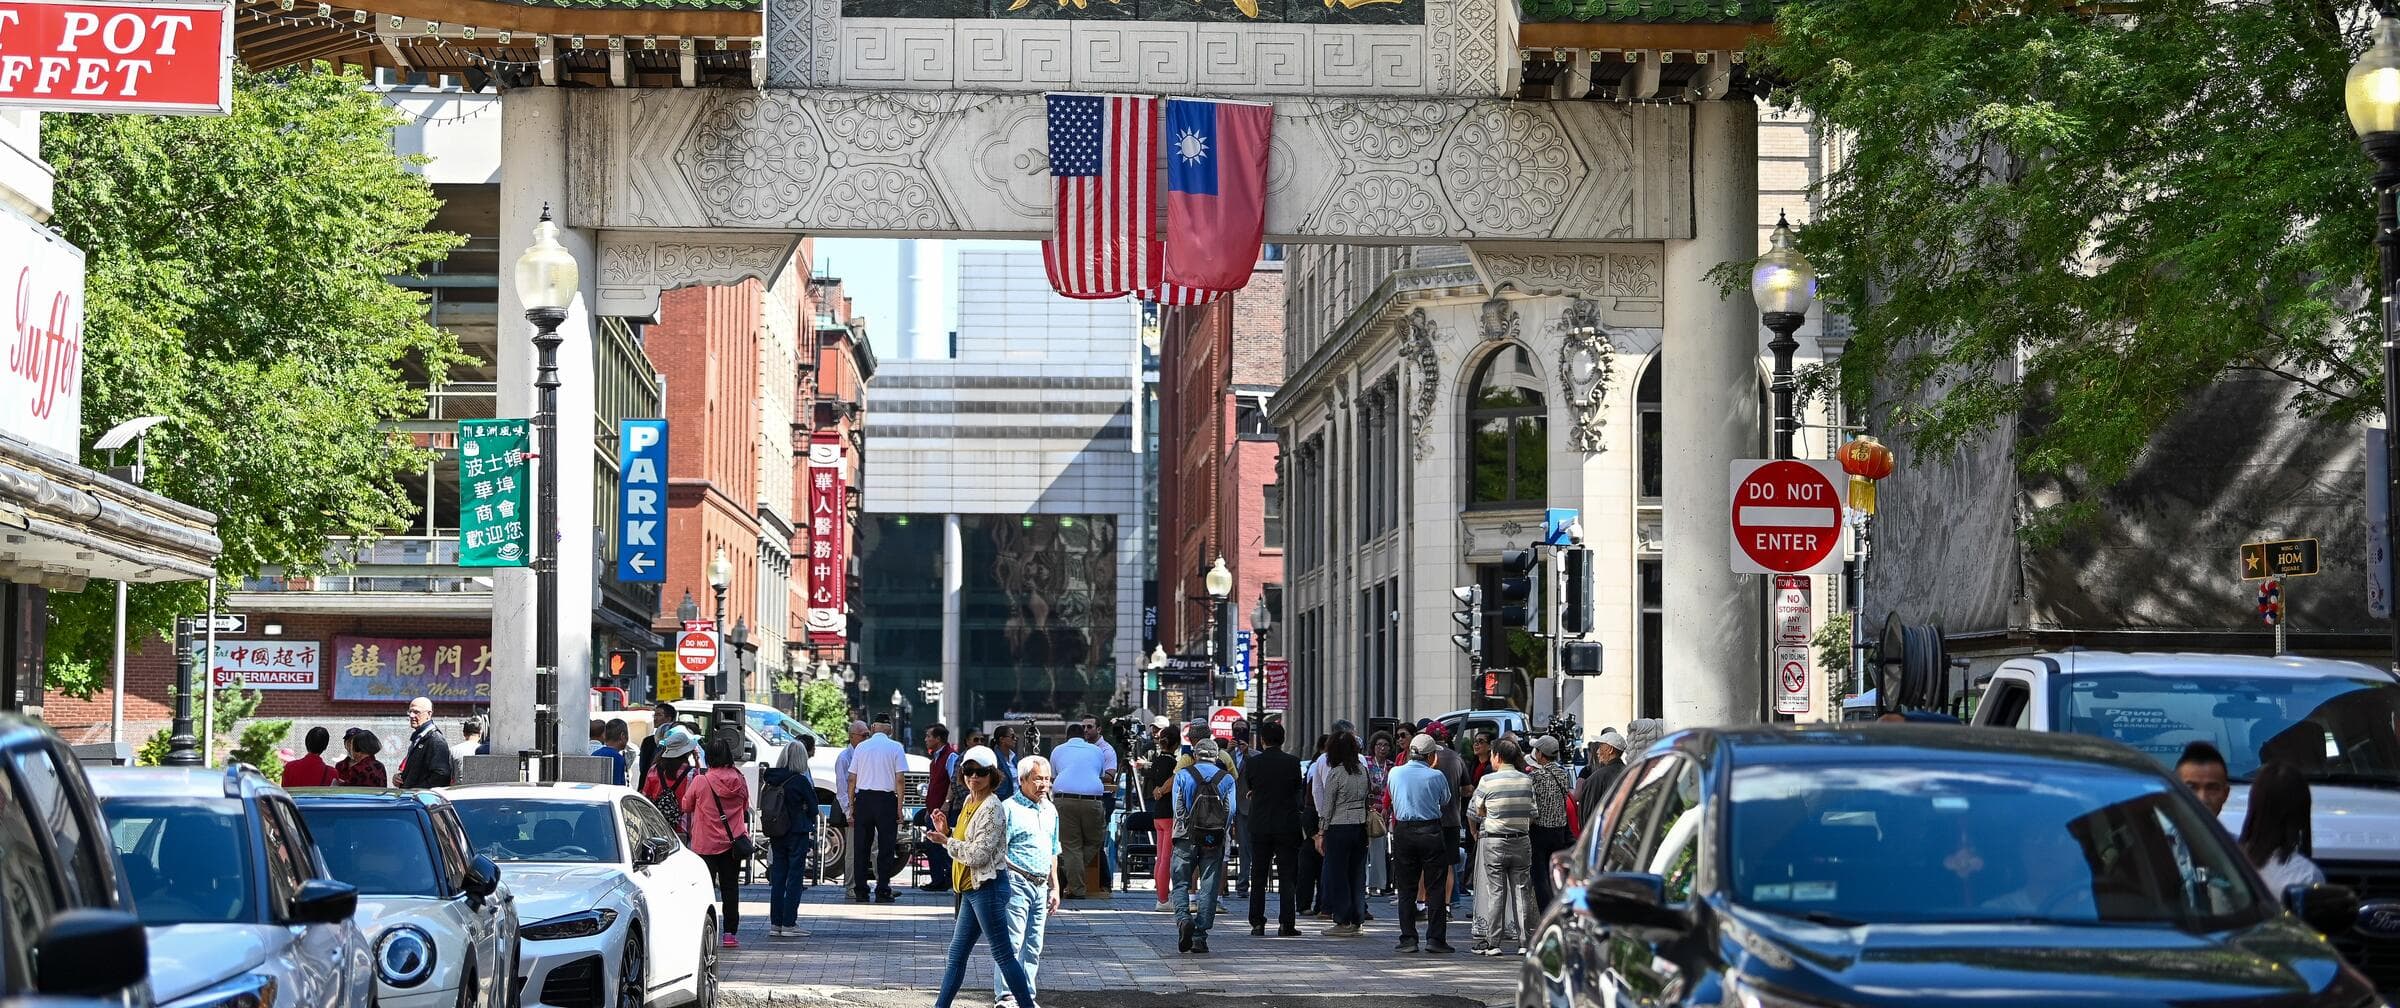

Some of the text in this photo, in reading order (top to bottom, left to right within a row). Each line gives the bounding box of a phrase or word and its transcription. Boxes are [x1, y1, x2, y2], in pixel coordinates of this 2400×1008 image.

[57, 12, 193, 55] POT
[11, 265, 78, 420] Buffet
[465, 448, 524, 478] 波士頓
[474, 476, 516, 500] 華埠
[627, 426, 659, 546] PARK
[1750, 482, 1823, 500] DO NOT
[475, 499, 516, 523] 商會
[466, 521, 525, 549] 歡迎您
[813, 472, 833, 603] 華人醫務中心
[1756, 533, 1817, 551] ENTER
[2278, 552, 2303, 565] HOM
[1778, 606, 1809, 614] STOPPING
[1787, 594, 1800, 604] NO
[1786, 625, 1802, 633] TIME
[230, 646, 316, 668] 中國超市
[217, 672, 313, 683] SUPERMARKET
[427, 683, 468, 696] Moon
